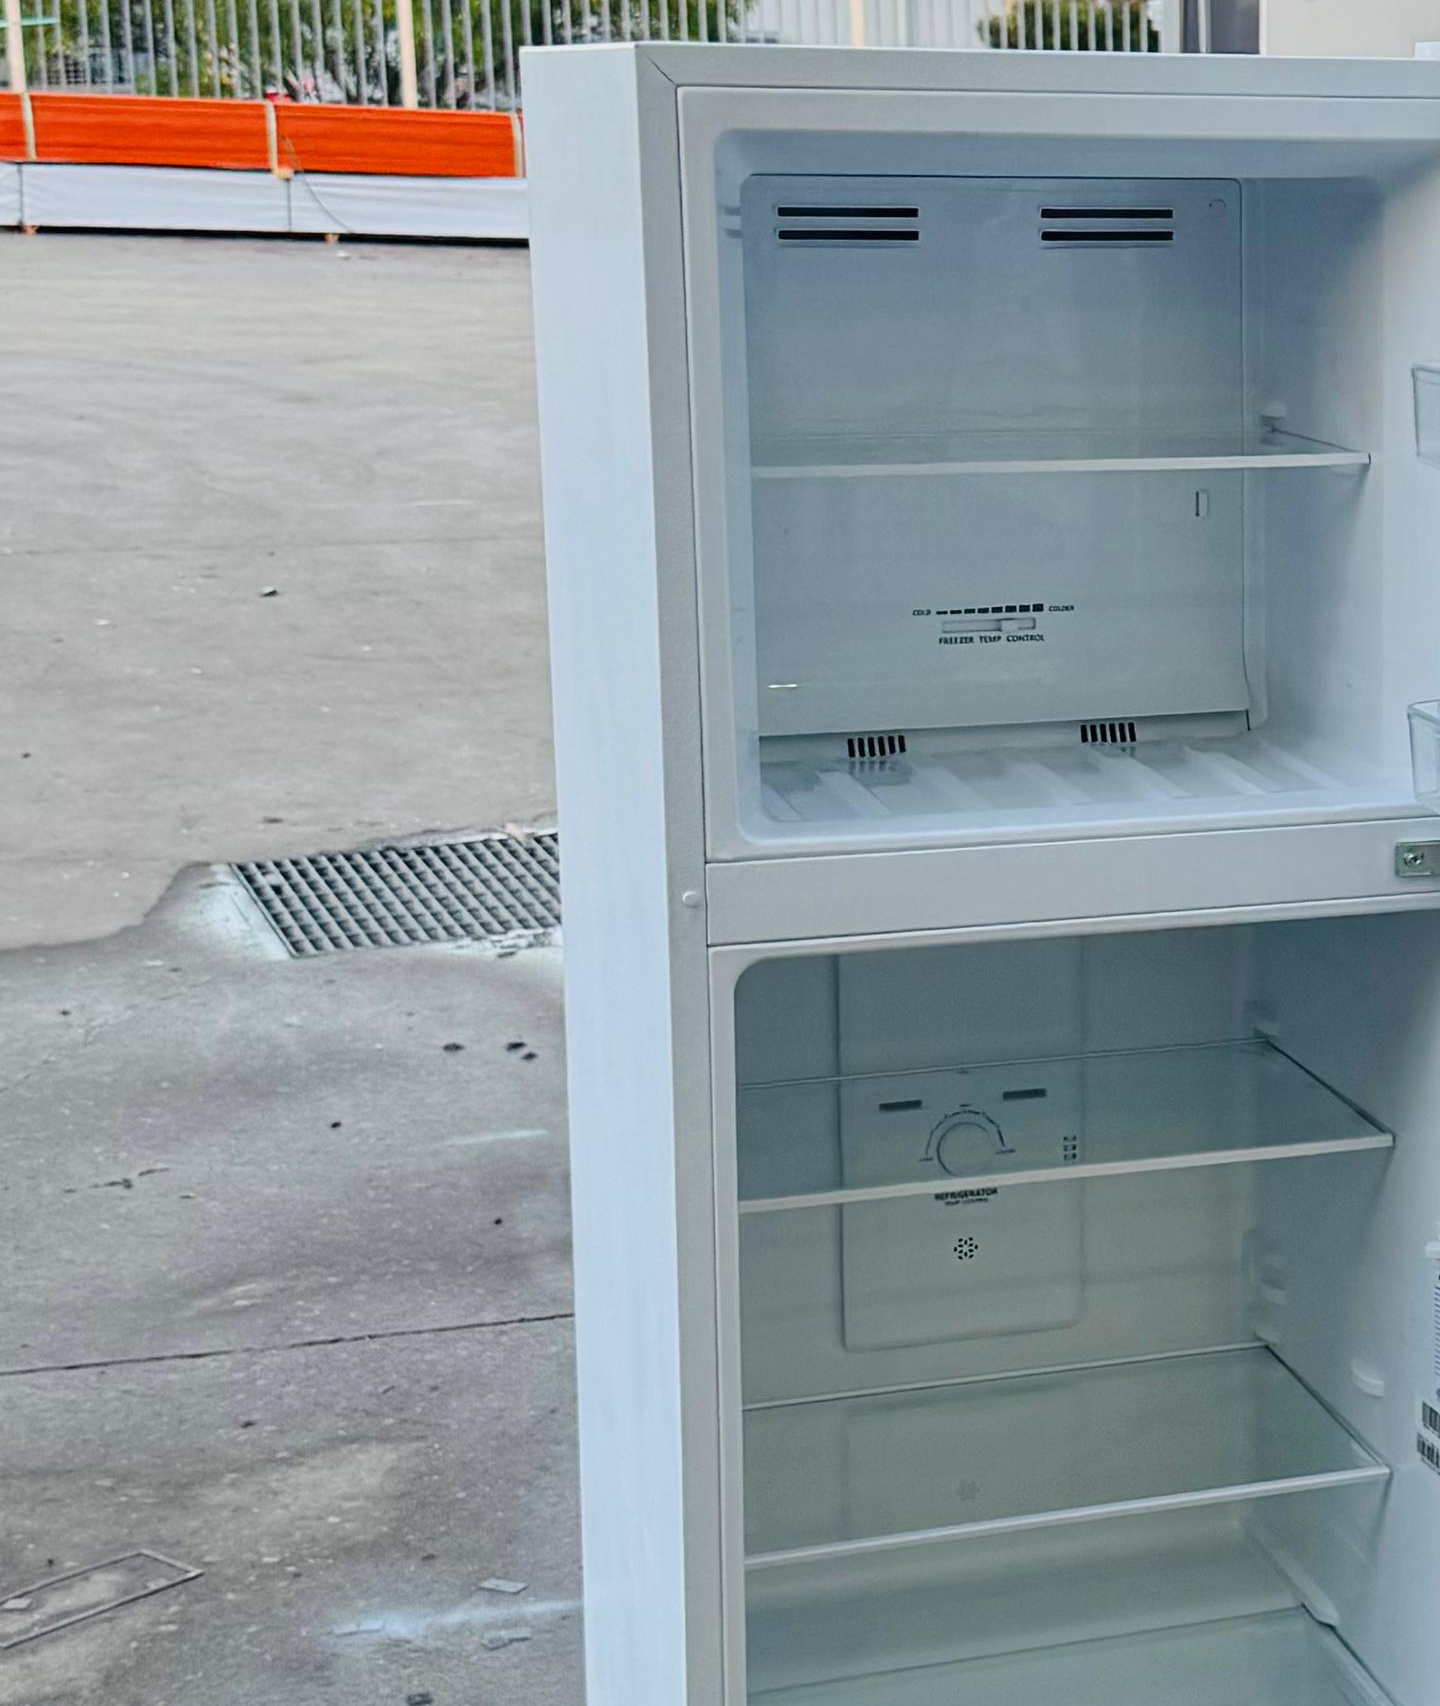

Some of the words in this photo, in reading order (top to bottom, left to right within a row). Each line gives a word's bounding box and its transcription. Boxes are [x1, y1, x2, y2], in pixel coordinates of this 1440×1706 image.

[938, 636, 974, 645] FREEZER
[979, 635, 1002, 643] TEMP
[1006, 634, 1045, 642] CONTROL
[934, 1187, 998, 1201] REFRIGERATOR
